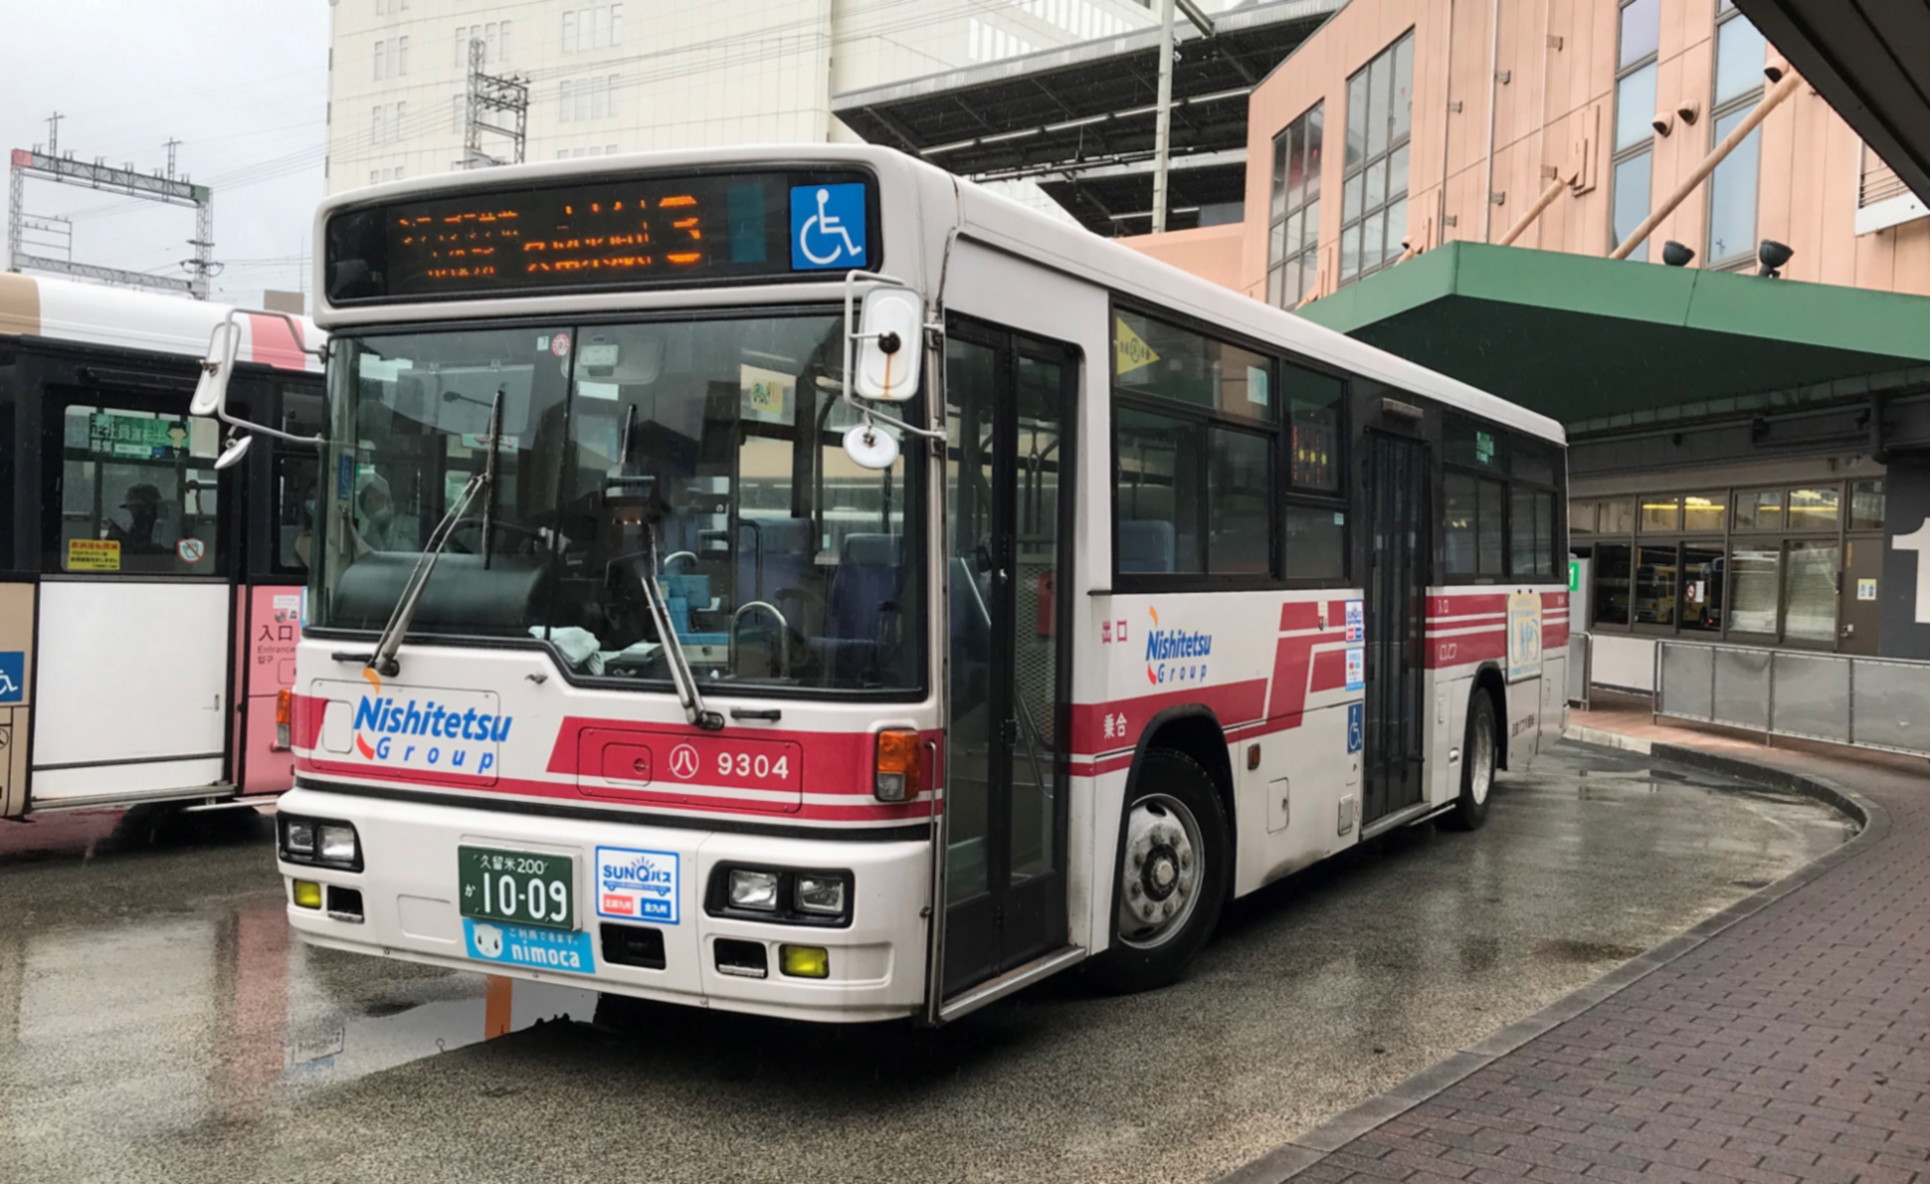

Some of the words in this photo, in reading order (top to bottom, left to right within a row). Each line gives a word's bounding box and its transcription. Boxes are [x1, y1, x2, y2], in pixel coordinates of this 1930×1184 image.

[659, 196, 700, 264] 3
[258, 624, 293, 641] 入口
[1102, 620, 1127, 644] 出口
[1145, 629, 1212, 661] Nishitetsu
[257, 645, 296, 654] Entrance
[1157, 663, 1206, 684] Group
[353, 694, 512, 742] Nishitetsu
[1104, 712, 1127, 739] 乗合
[376, 736, 494, 774] Group
[717, 752, 789, 779] 9304
[464, 883, 476, 898] か
[483, 872, 567, 922] 10-09
[511, 939, 581, 968] nimoca
